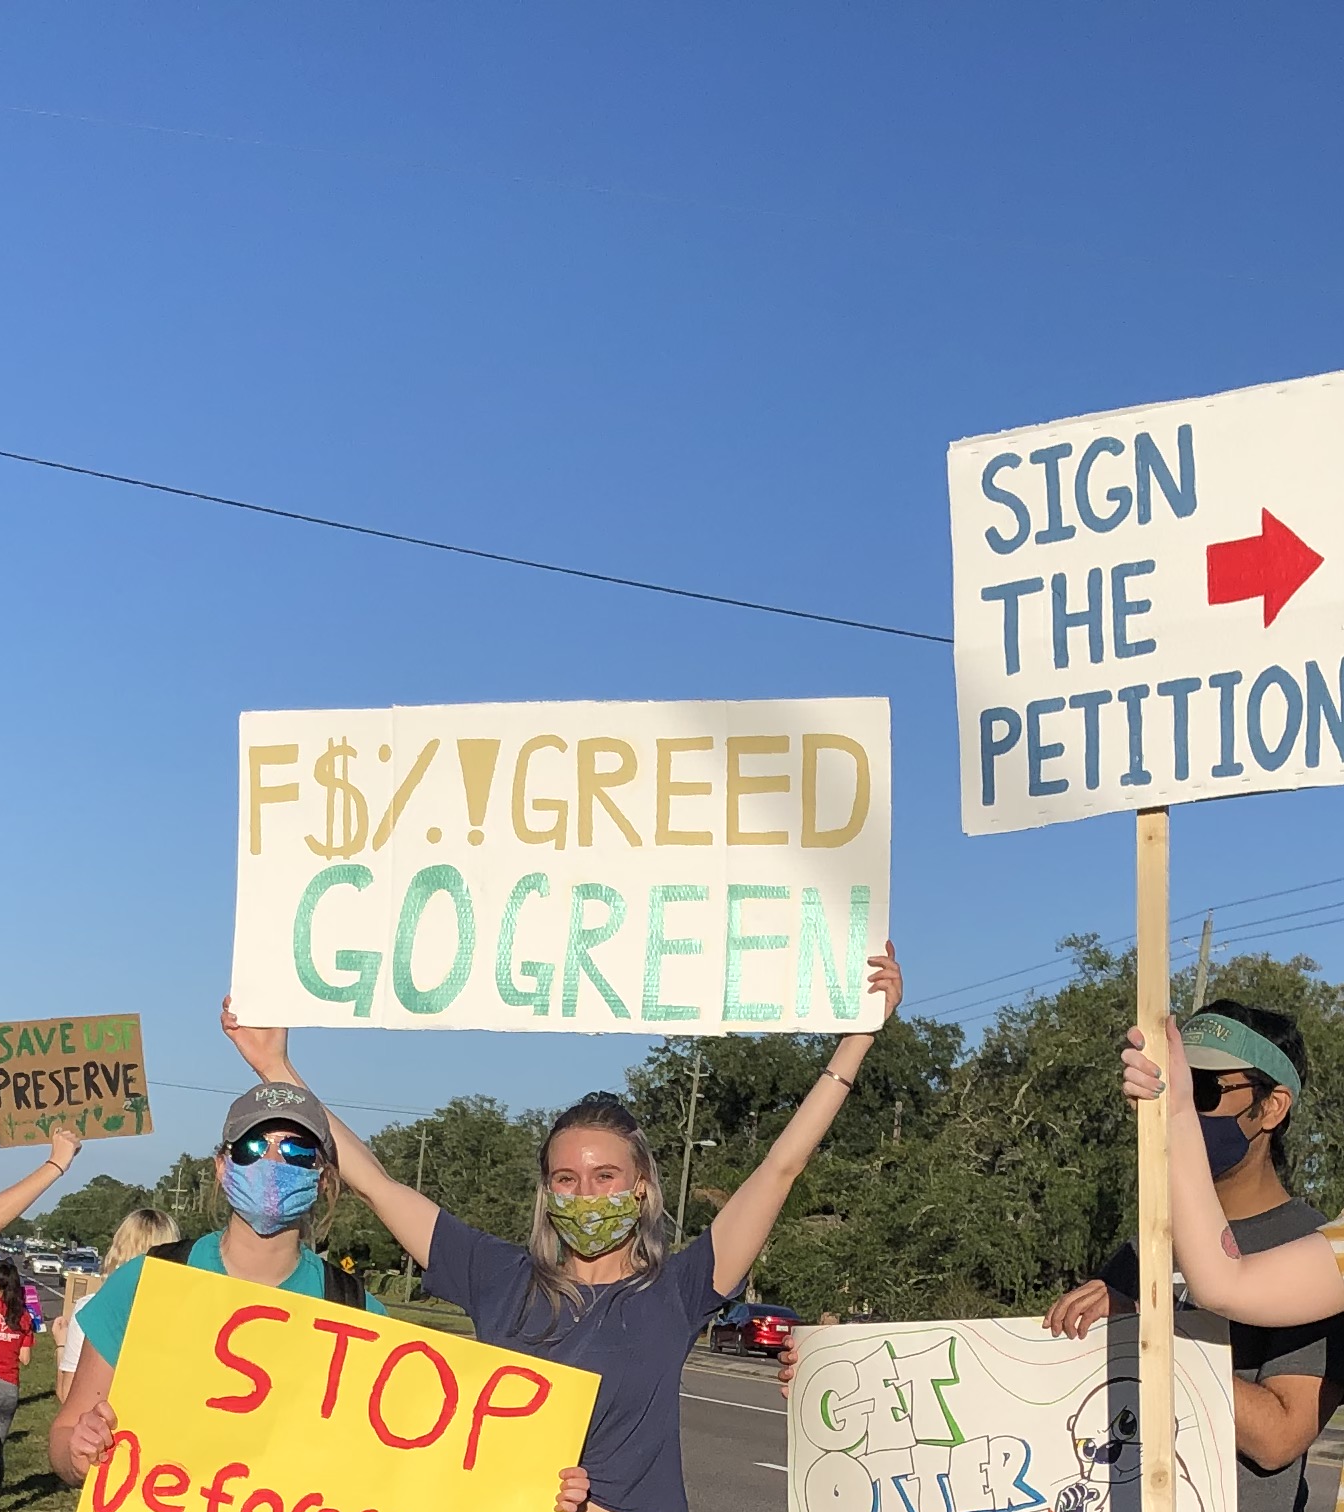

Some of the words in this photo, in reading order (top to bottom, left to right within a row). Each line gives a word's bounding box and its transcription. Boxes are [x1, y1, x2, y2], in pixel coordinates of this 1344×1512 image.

[981, 423, 1198, 556] SIGN
[980, 558, 1157, 677] THE
[510, 732, 872, 851] GREED
[292, 863, 477, 1018] GO
[494, 871, 872, 1022] GREEN
[205, 1305, 553, 1471] STOP
[800, 1336, 965, 1453] GET
